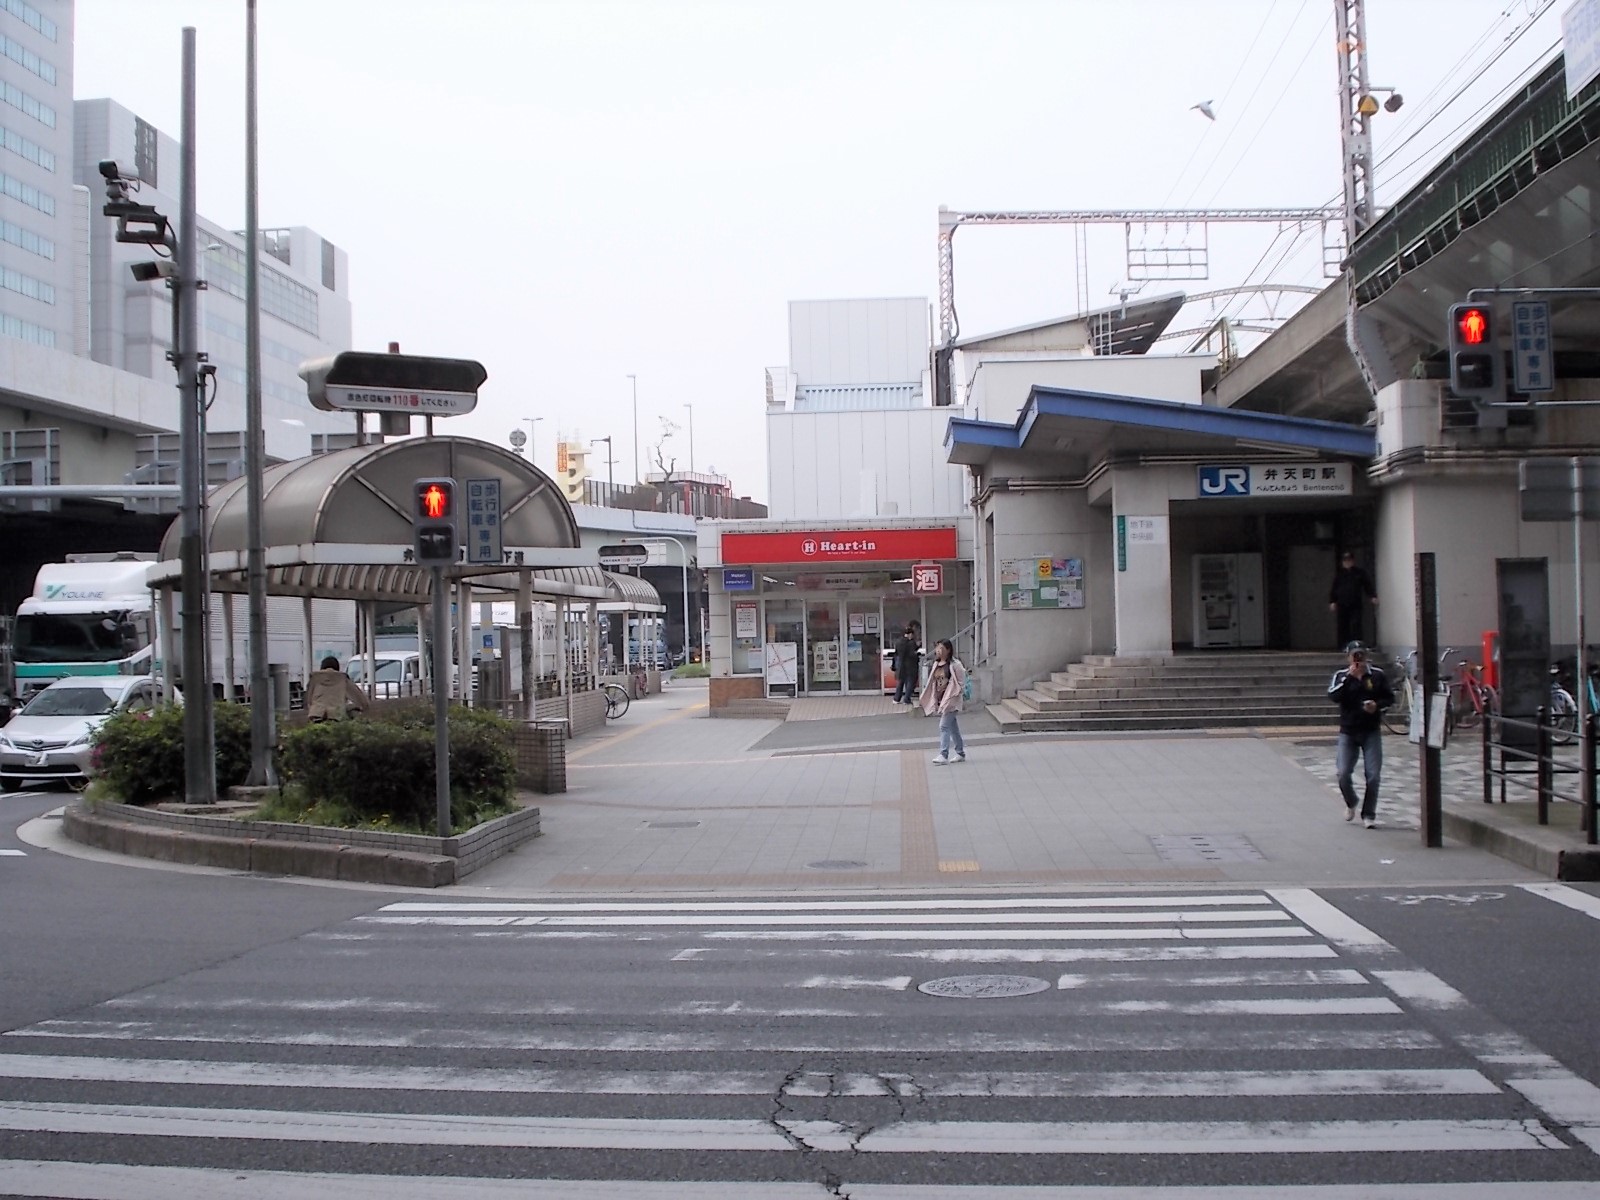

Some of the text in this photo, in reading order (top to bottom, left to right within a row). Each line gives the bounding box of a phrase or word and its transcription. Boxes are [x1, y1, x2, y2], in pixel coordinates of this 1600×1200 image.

[1202, 468, 1248, 493] JR
[1264, 467, 1336, 480] 弁天町駅
[1256, 484, 1298, 492] べんてんちょう
[471, 484, 483, 526] 自転車
[485, 484, 497, 526] 歩行者
[479, 530, 491, 558] 専用
[820, 540, 876, 551] Heart-in
[916, 569, 939, 591] 酒
[61, 591, 104, 599] YOULINE
